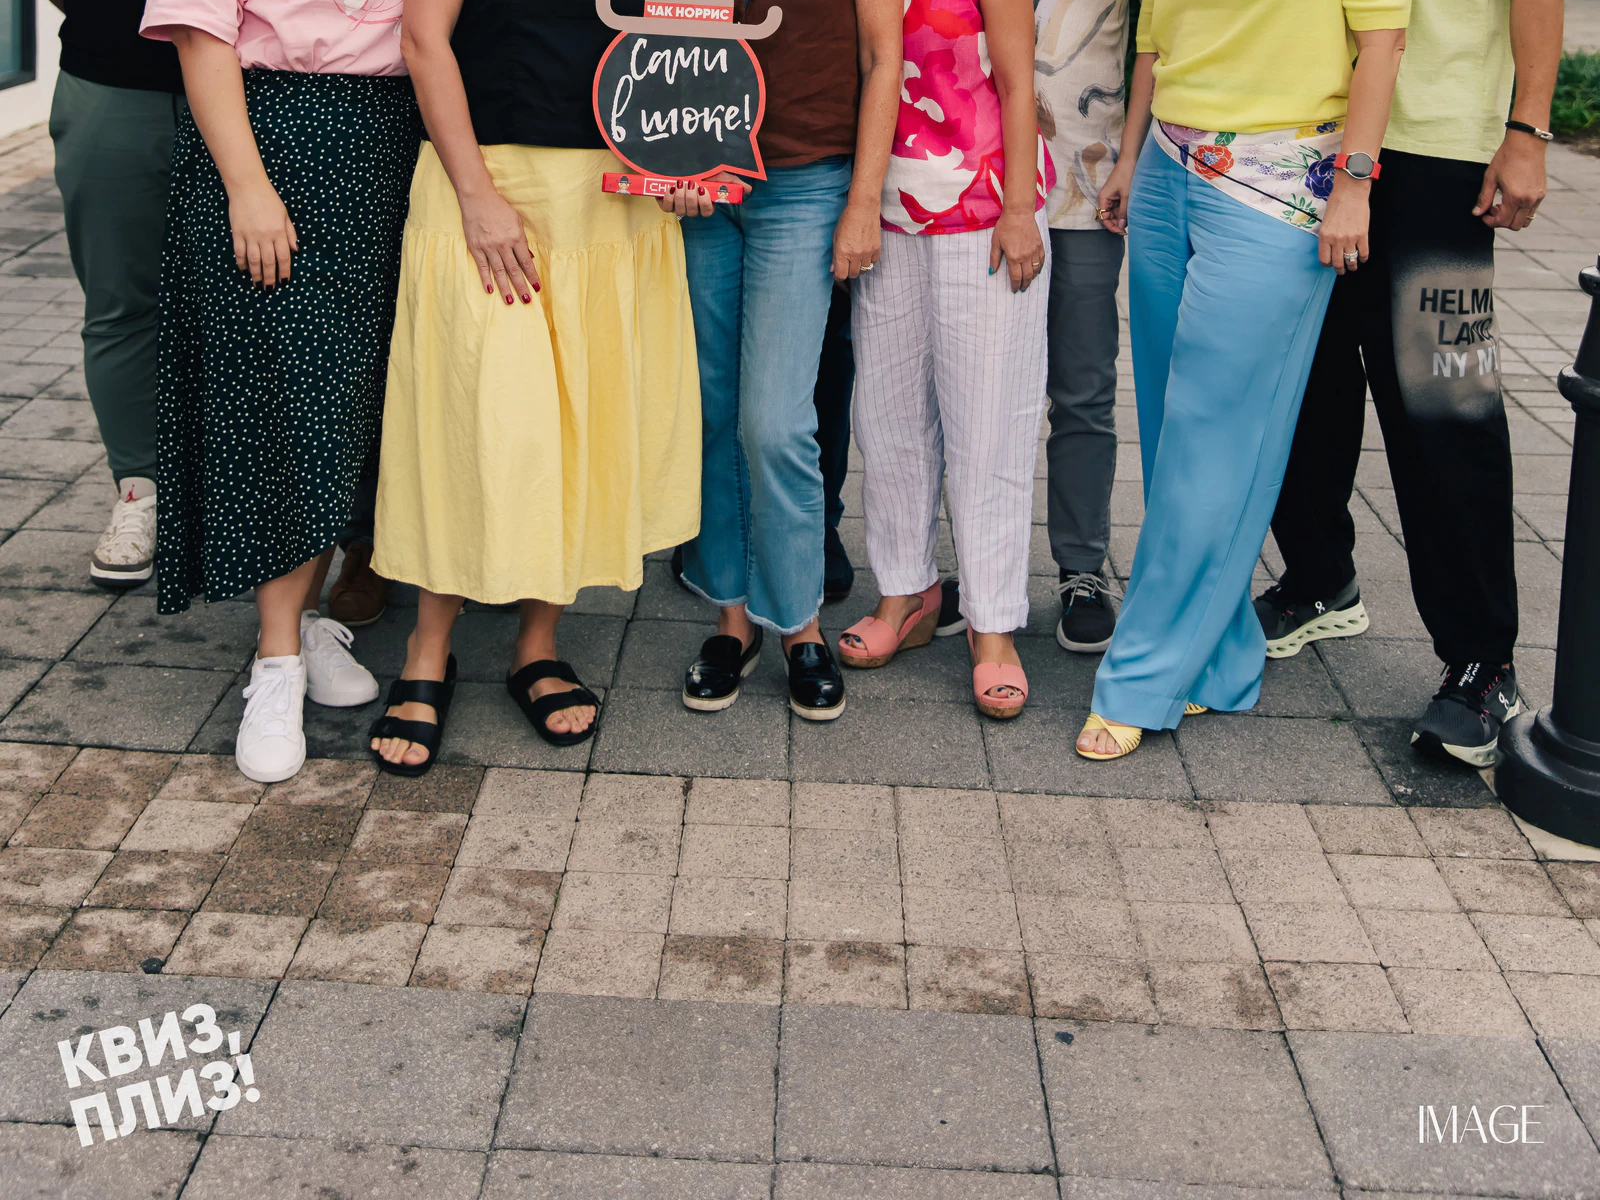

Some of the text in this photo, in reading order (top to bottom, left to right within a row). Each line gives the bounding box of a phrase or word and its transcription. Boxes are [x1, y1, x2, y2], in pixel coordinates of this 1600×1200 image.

[646, 4, 730, 20] ЧАК НОРРИС
[630, 38, 728, 85] Сами
[611, 74, 752, 143] в шоке!
[1432, 351, 1468, 378] NY
